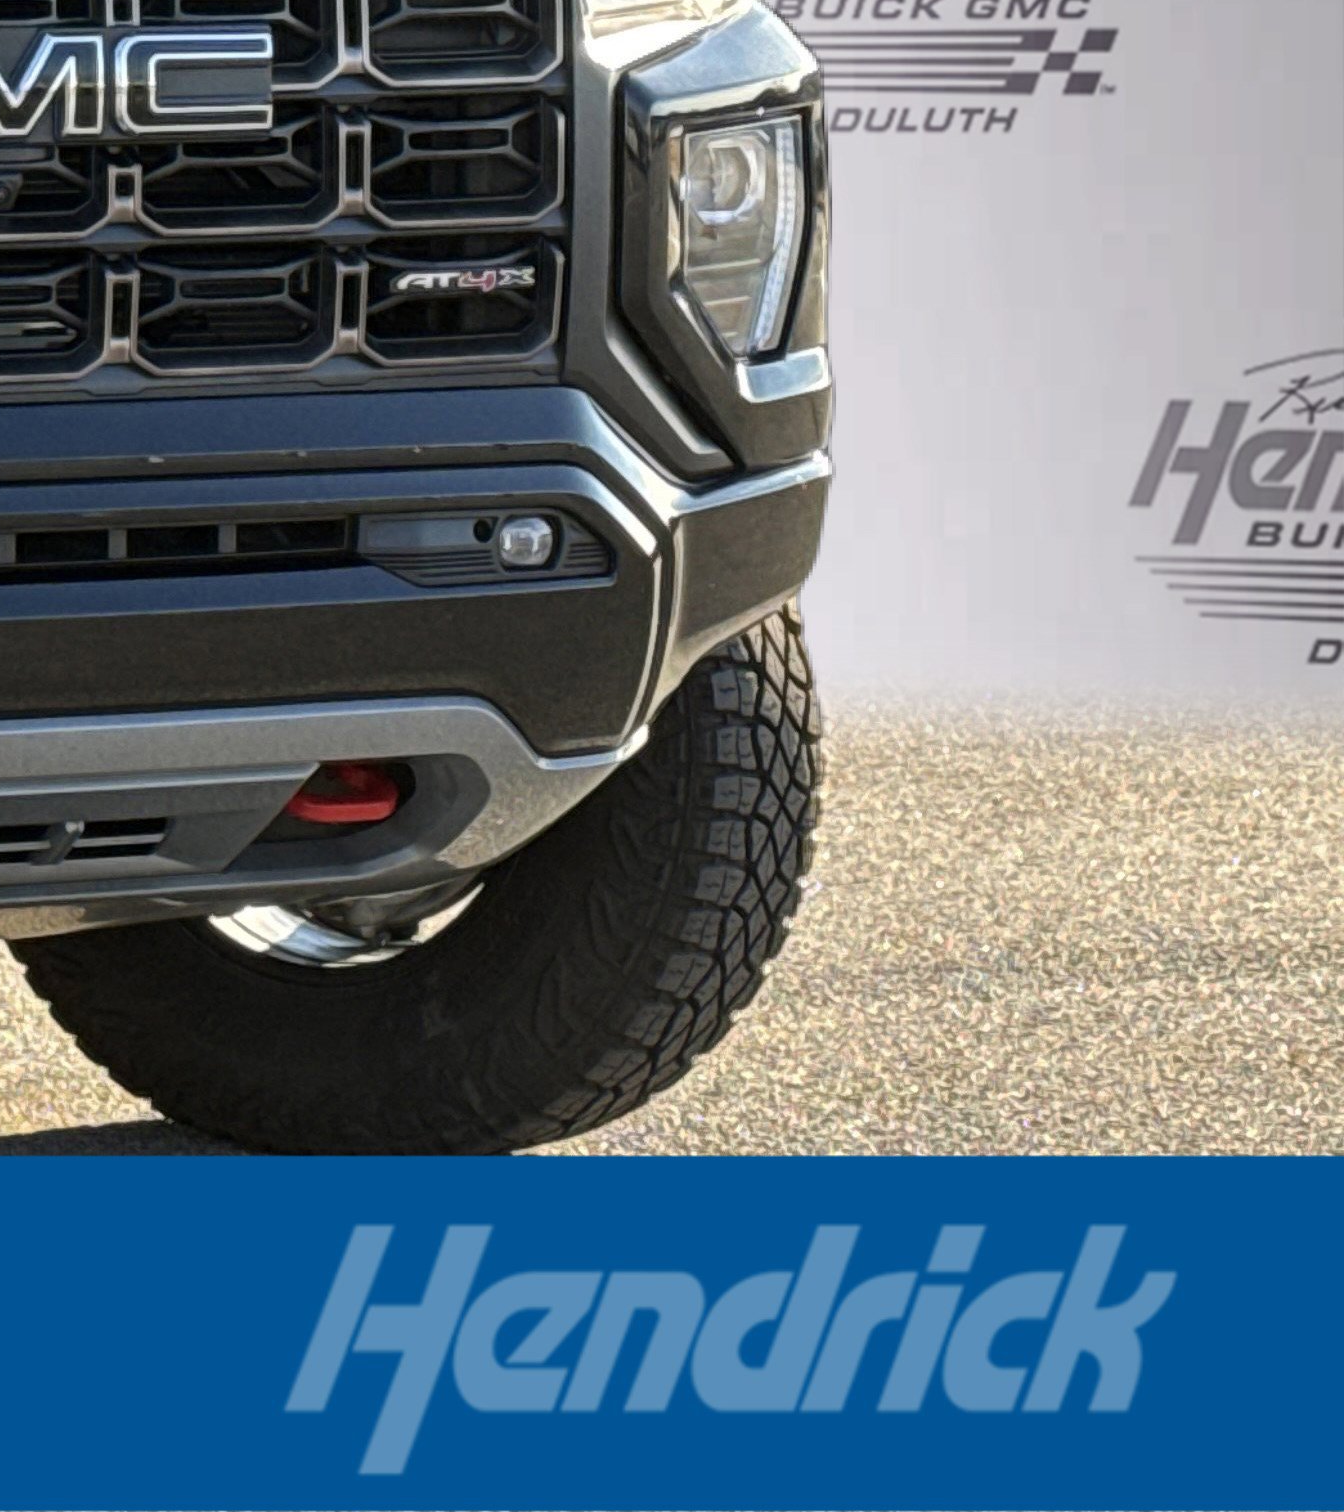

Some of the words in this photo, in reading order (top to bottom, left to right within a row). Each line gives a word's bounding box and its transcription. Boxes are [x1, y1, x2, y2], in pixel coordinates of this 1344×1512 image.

[830, 107, 1018, 133] DULUTH
[396, 266, 536, 292] AT4X
[1247, 521, 1344, 549] BUI
